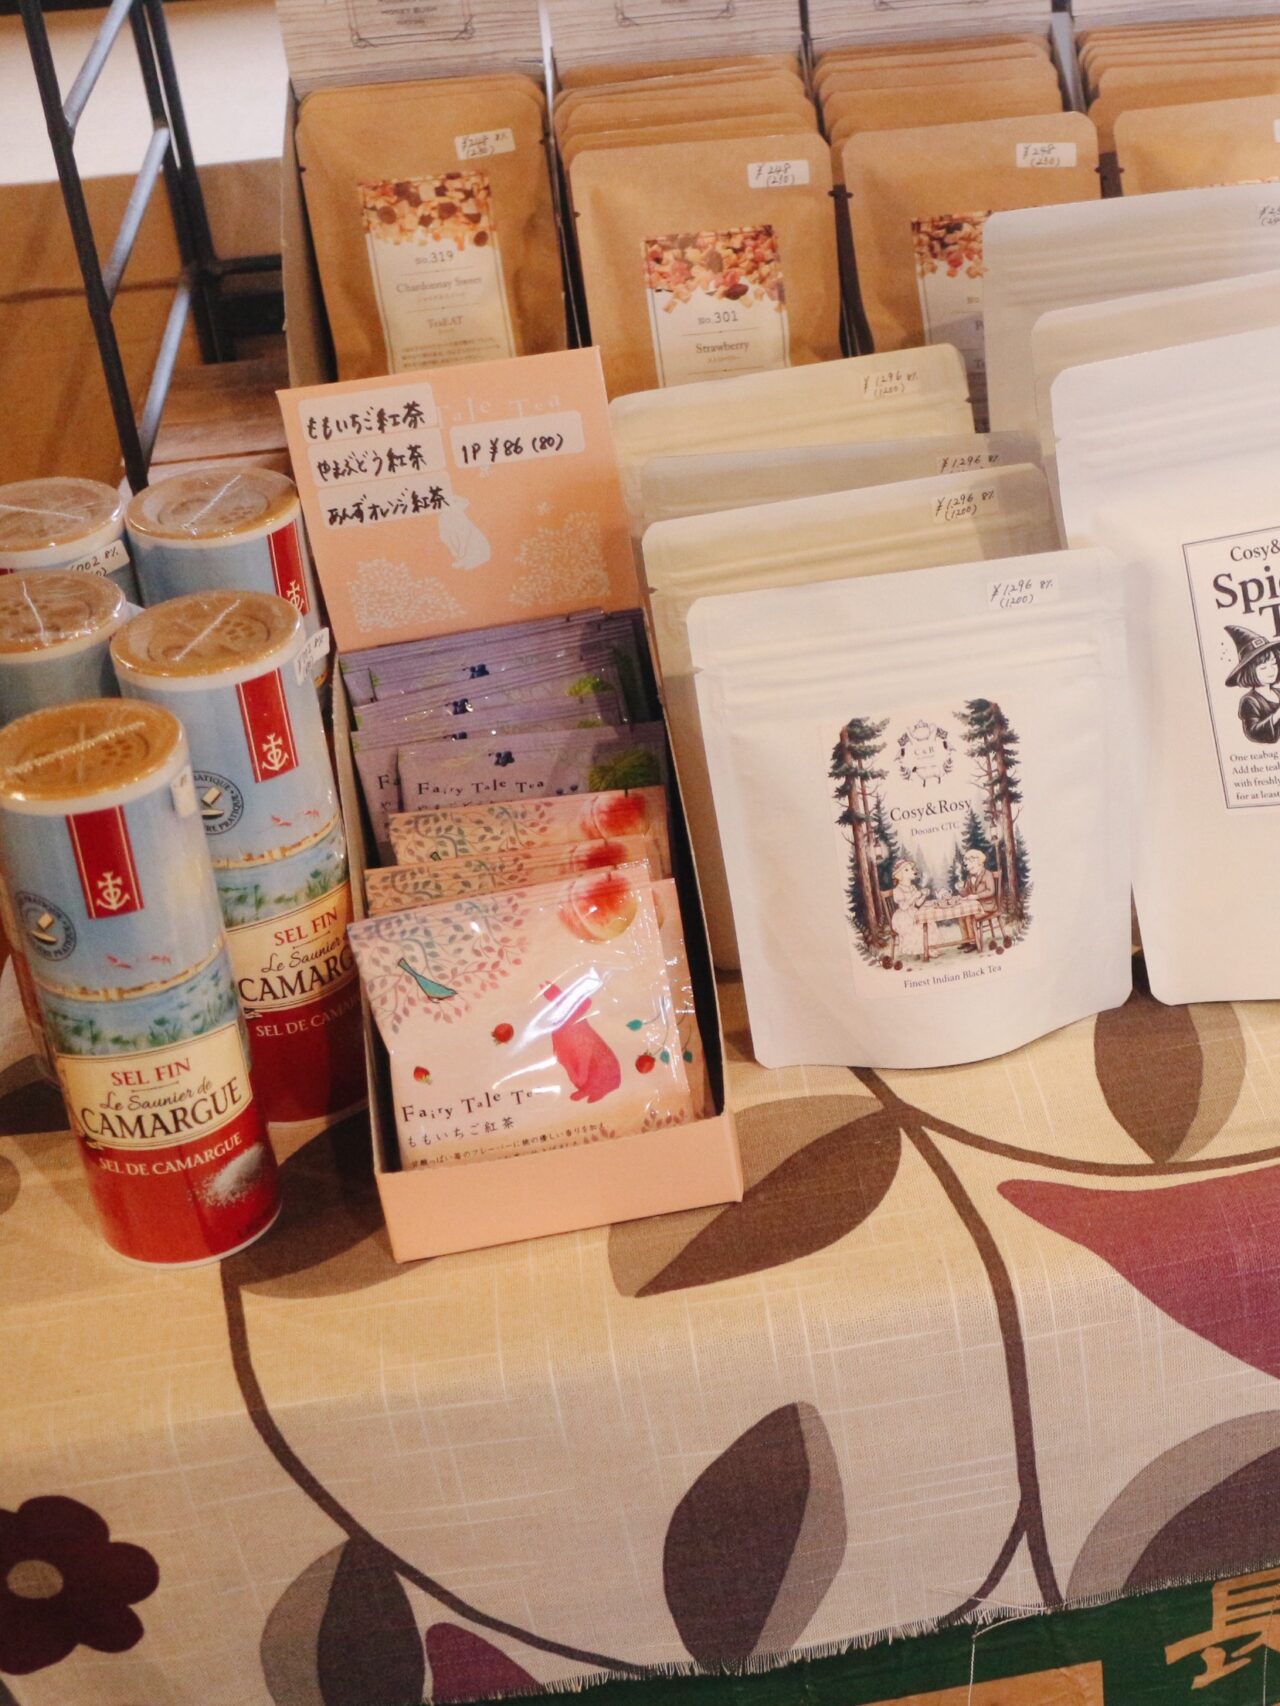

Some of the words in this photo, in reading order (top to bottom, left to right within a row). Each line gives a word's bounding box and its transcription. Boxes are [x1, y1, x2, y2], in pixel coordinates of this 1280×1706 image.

[695, 341, 749, 354] Strawberry
[307, 400, 426, 440] ももいちご紅茶
[317, 444, 427, 482] やまぶどう紅茶
[489, 436, 524, 463] ¥86
[531, 433, 564, 454] (80)
[327, 486, 449, 526] あんずオレンジ紅茶
[1229, 754, 1248, 762] One
[1250, 749, 1279, 760] teabag
[1232, 765, 1249, 775] Add
[1250, 763, 1264, 773] the
[417, 782, 464, 797] Fairy
[471, 778, 507, 794] Tale
[515, 778, 545, 794] Tea
[1233, 778, 1252, 789] with
[1236, 792, 1250, 801] for
[1250, 791, 1259, 800] at
[1260, 788, 1280, 799] least
[273, 926, 308, 947] SEL
[311, 907, 338, 934] FIN
[261, 953, 286, 974] Le
[288, 936, 342, 968] Saunier
[903, 978, 931, 989] Finest
[932, 973, 961, 985] Indian
[962, 967, 986, 980] Black
[987, 964, 1003, 975] Tea
[255, 1024, 284, 1037] SEL
[285, 1020, 309, 1035] DE
[111, 1070, 151, 1087] SEL
[154, 1057, 192, 1082] FIN
[81, 1076, 243, 1140] CAMARGUE
[100, 1091, 124, 1112] Le
[127, 1084, 195, 1112] Saunier
[197, 1075, 213, 1094] de
[402, 1105, 453, 1123] Fairy
[461, 1091, 501, 1114] Tale
[510, 1089, 536, 1105] Te
[408, 1116, 514, 1148] ももいちご紅茶
[99, 1157, 125, 1175] SEL
[126, 1163, 150, 1176] DE
[152, 1132, 243, 1176] CAMARGUE
